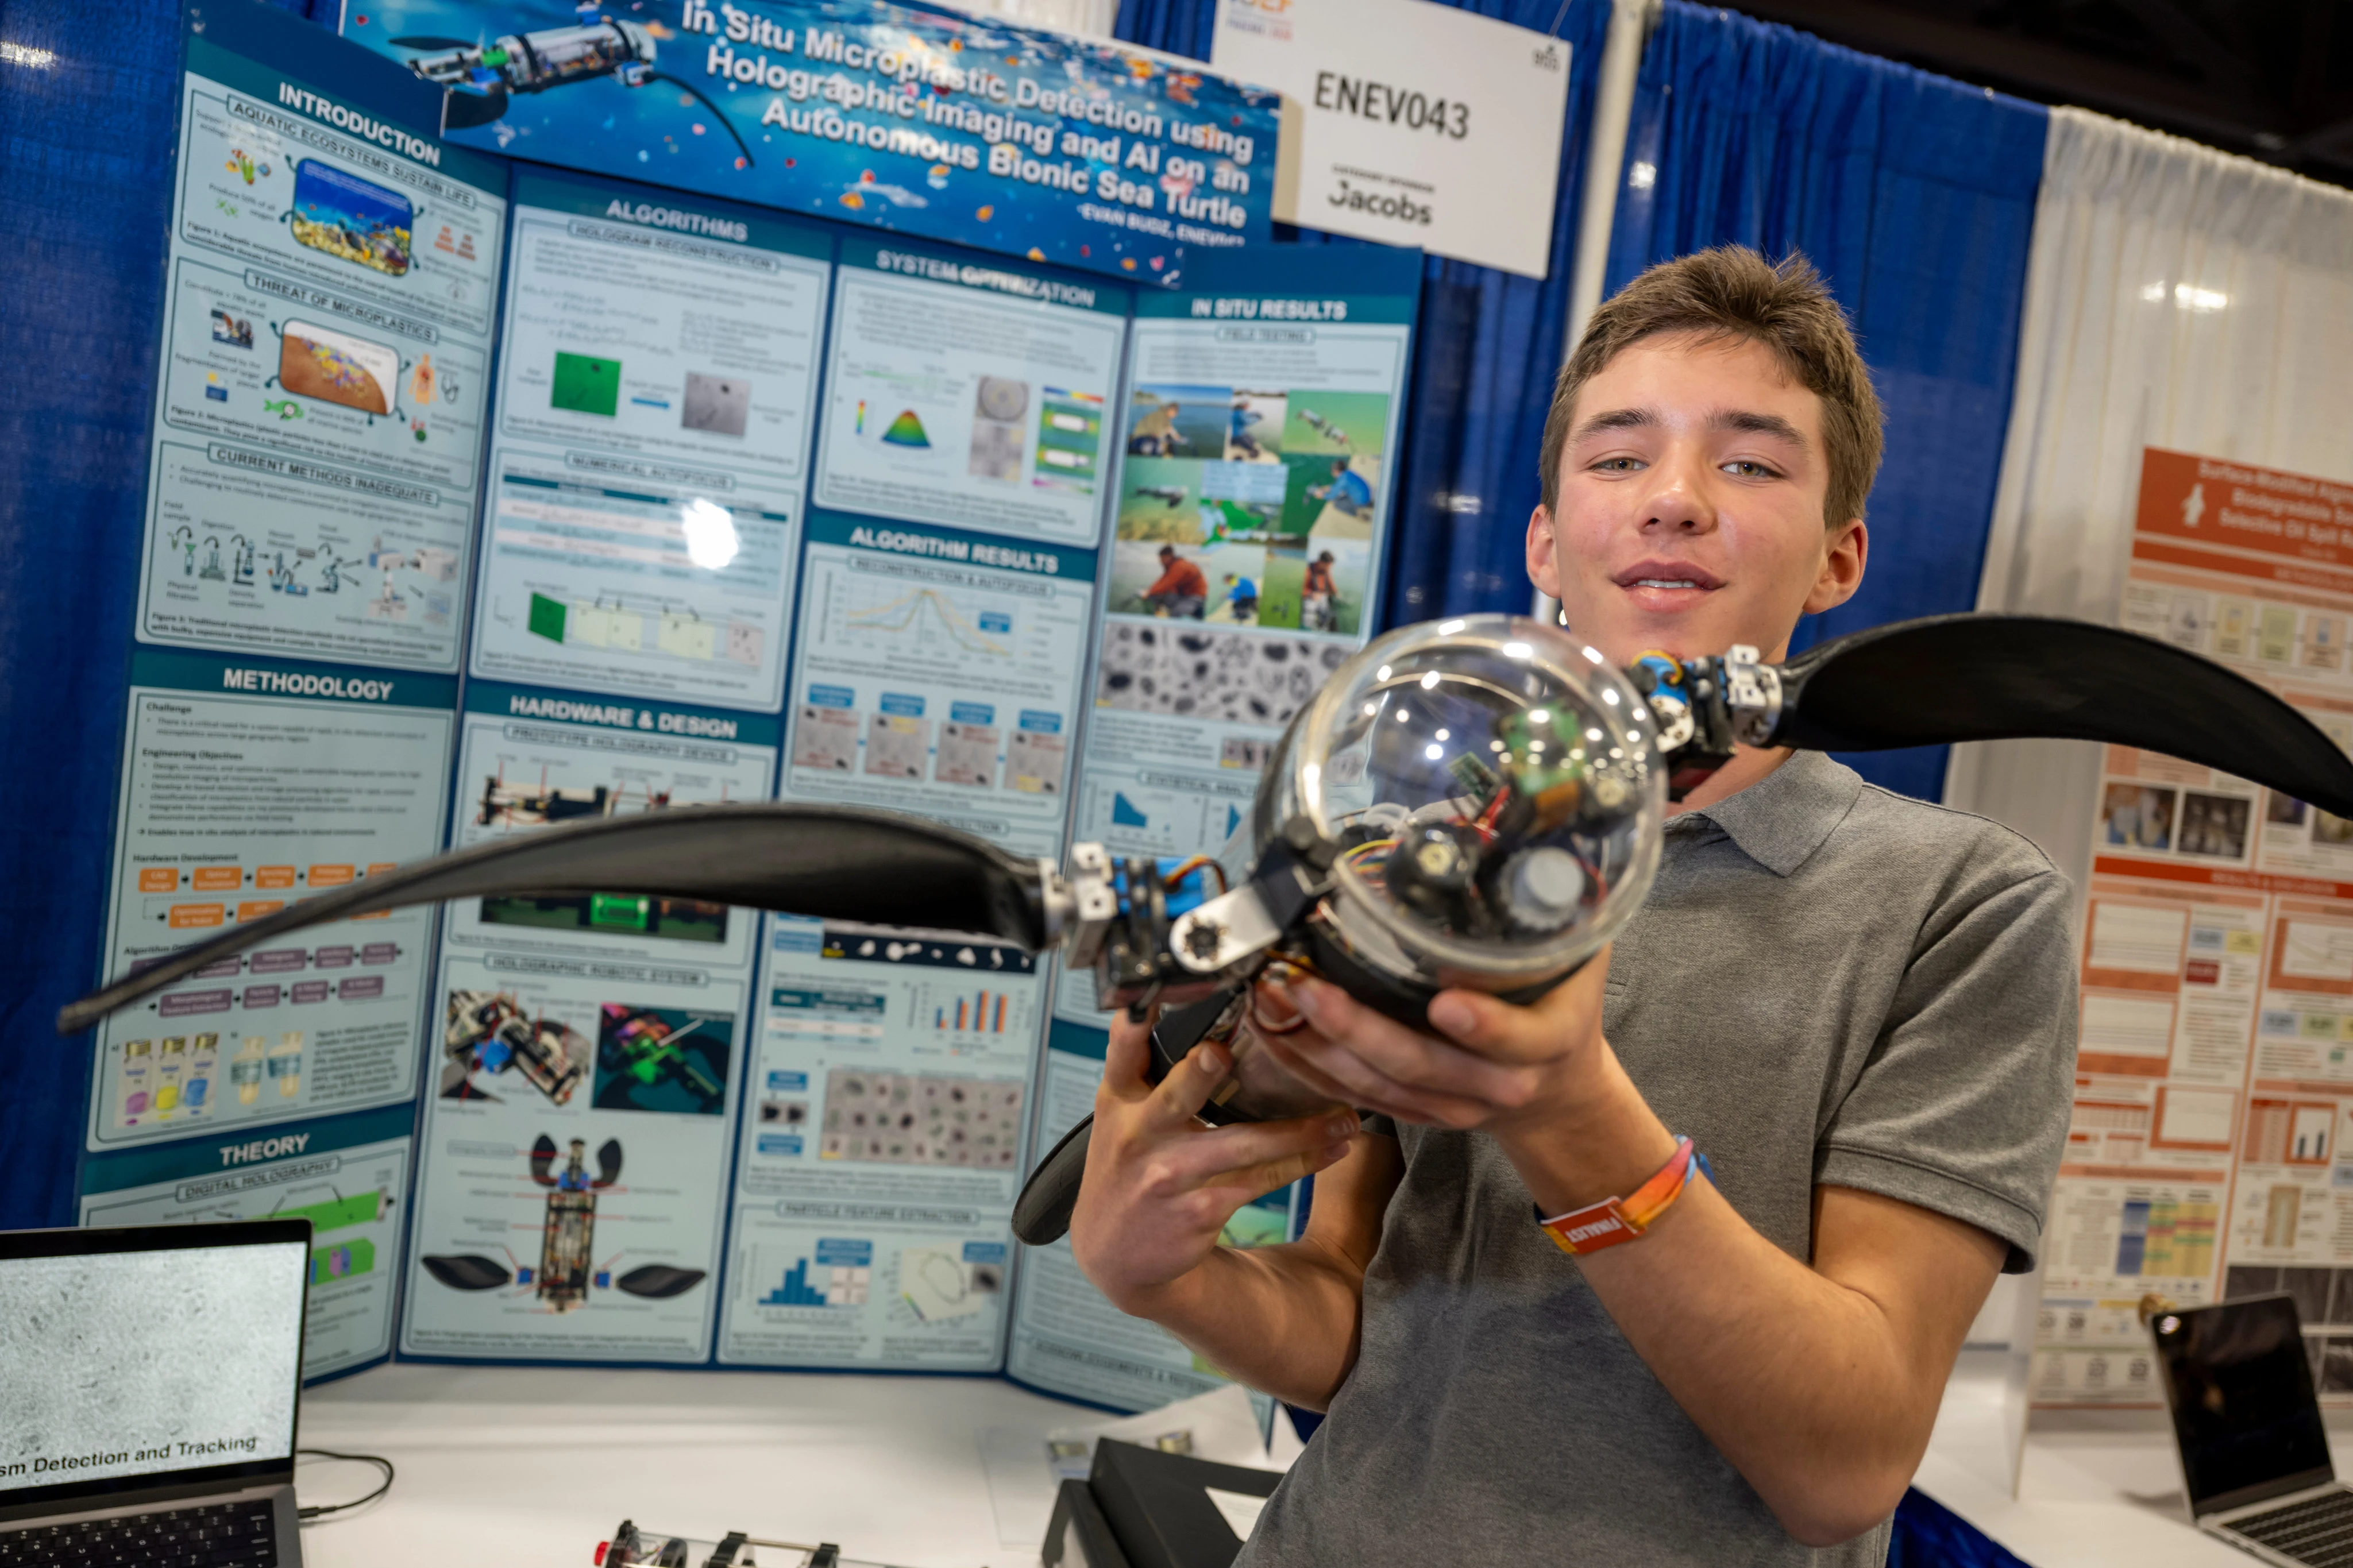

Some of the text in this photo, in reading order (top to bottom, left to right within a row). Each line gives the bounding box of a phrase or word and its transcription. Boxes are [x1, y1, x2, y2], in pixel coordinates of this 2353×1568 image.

[682, 0, 1253, 165] In Situ Microplastic Detection using
[279, 82, 440, 166] INTRODUCTION
[707, 44, 1249, 195] Holographic Imaging and AI on an
[1313, 71, 1471, 141] ENEV043
[234, 102, 297, 136] AQUATIC
[300, 128, 389, 173] ECOSYSTEMS
[393, 165, 443, 194] SUSTAIN
[446, 187, 471, 204] LIFE
[762, 98, 1247, 230] Autonomous Bionic Sea Turtle
[606, 199, 748, 242] ALGORITHMS
[1328, 180, 1433, 227] Jacobs
[877, 249, 958, 280] SYSTEM
[253, 276, 431, 339] THREAT OF MICROPLASTICS
[1191, 298, 1347, 320] IN SITU RESULTS
[217, 448, 285, 473] CURRENT
[289, 461, 351, 486] METHODS
[355, 477, 432, 503] INADEQUATE
[850, 527, 1059, 574] ALGORITHM RESULTS
[223, 668, 394, 700] METHODOLOGY
[146, 702, 192, 715] Challenge
[510, 696, 737, 739] HARDWARE & DESIGN
[142, 748, 196, 760] Engineering
[219, 1133, 310, 1167] THEORY
[185, 1160, 333, 1199] DIGITAL HOLOGRAPHY
[33, 1450, 129, 1474] Detection
[135, 1444, 169, 1459] and
[178, 1436, 257, 1457] Tracking
